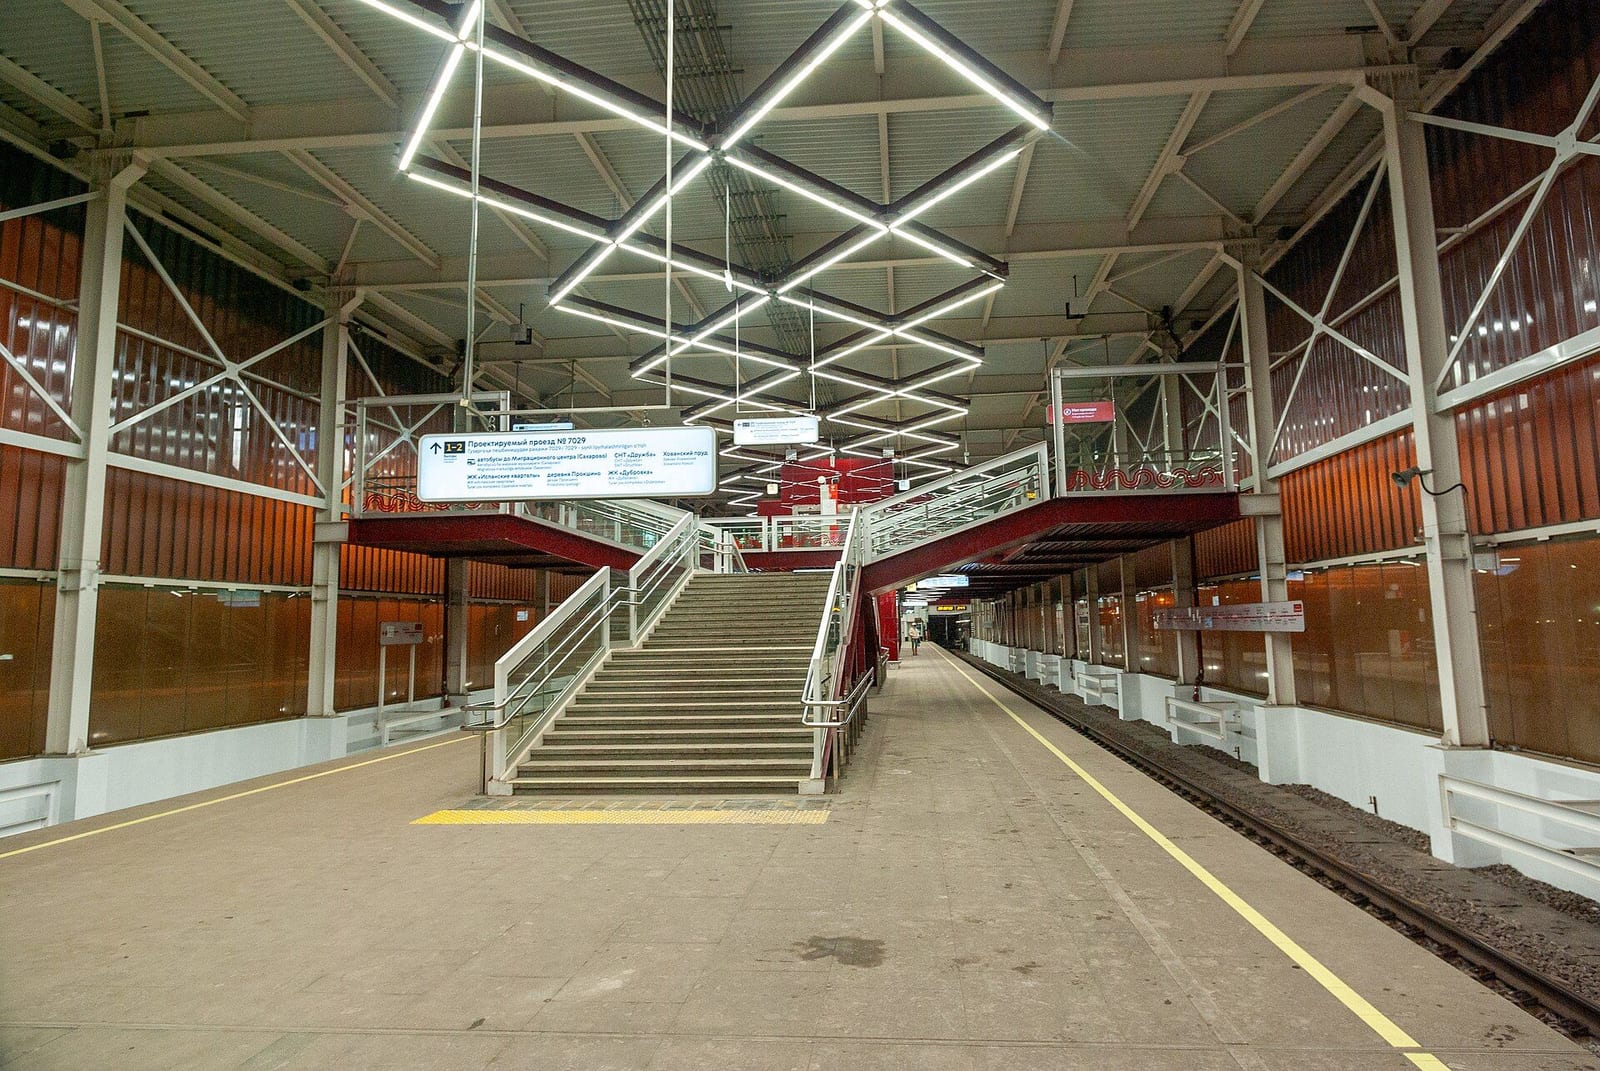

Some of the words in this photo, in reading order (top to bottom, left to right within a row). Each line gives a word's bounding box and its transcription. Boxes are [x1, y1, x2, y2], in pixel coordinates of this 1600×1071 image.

[468, 439, 527, 448] Проектируемый
[529, 439, 556, 447] проезд
[568, 436, 586, 444] 7029
